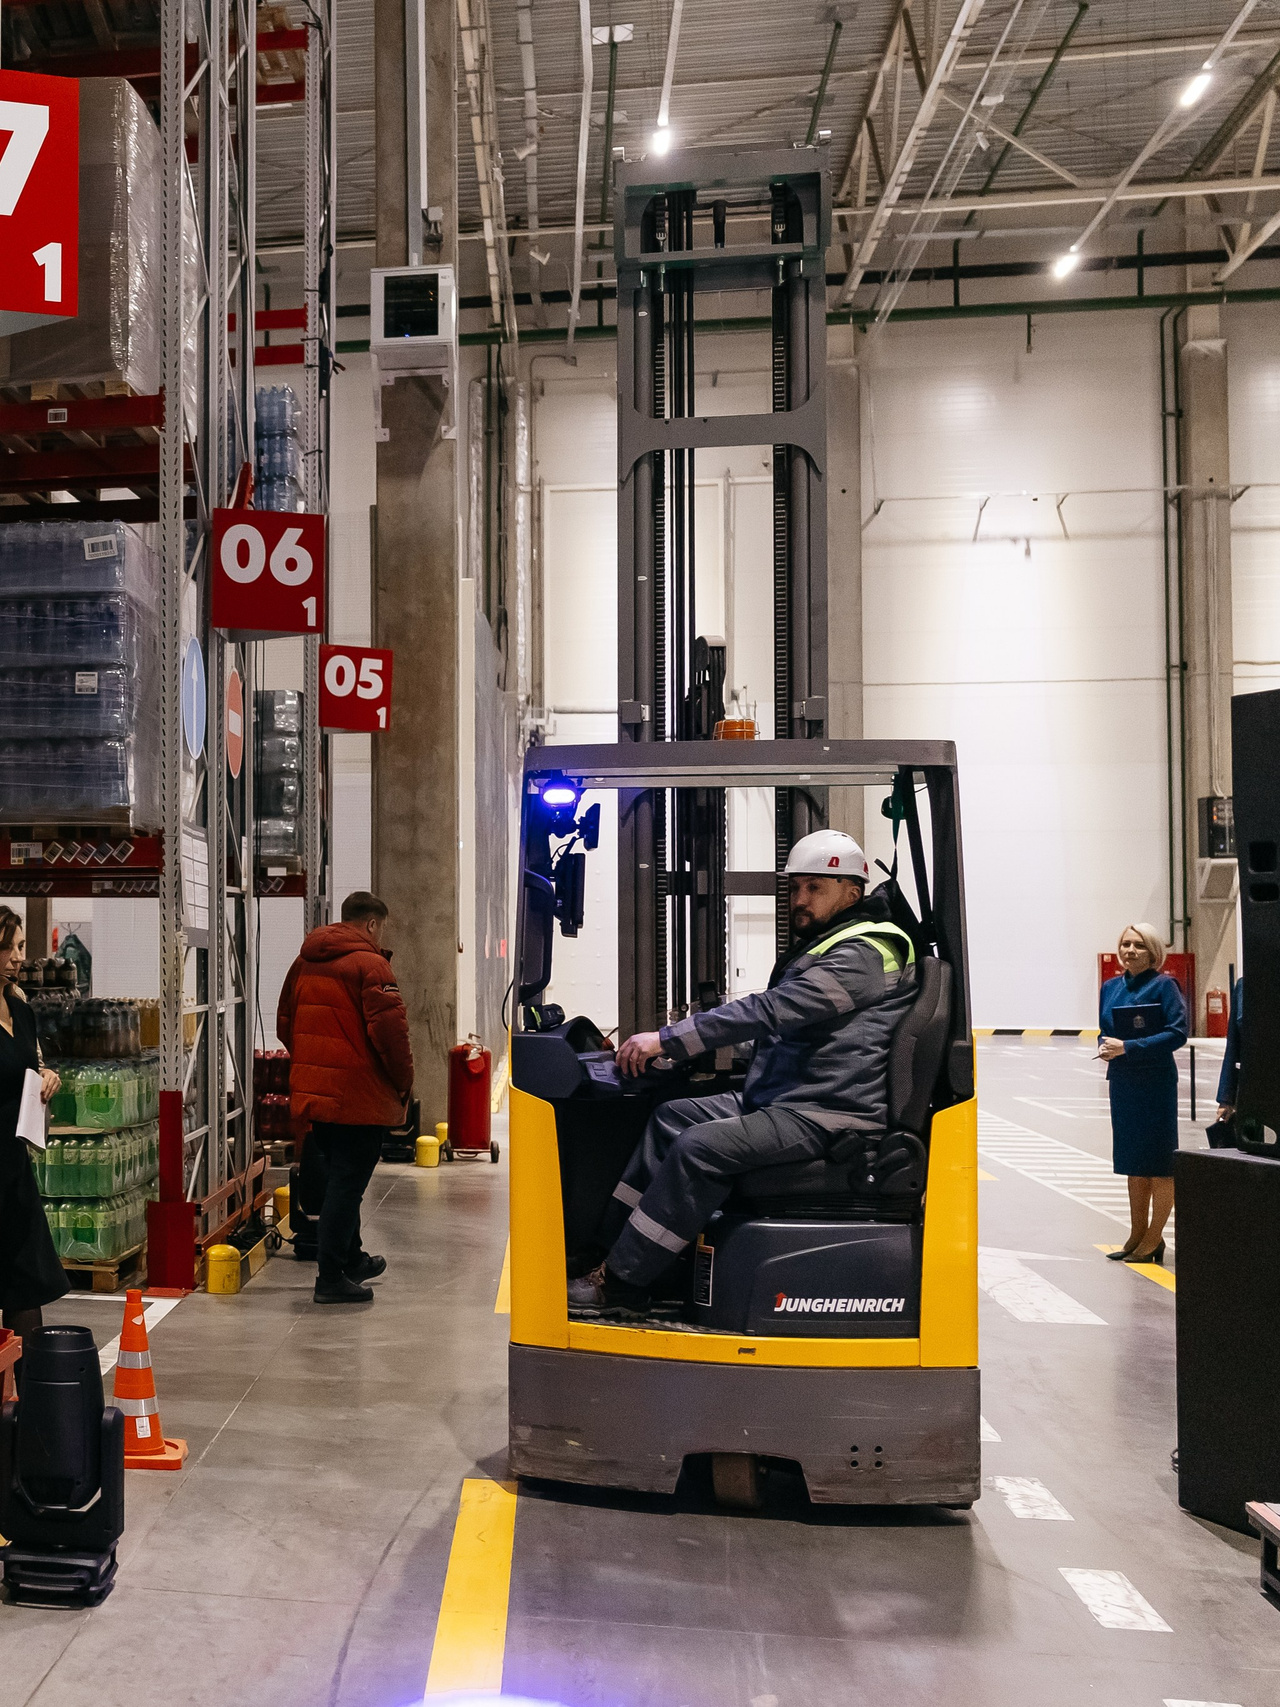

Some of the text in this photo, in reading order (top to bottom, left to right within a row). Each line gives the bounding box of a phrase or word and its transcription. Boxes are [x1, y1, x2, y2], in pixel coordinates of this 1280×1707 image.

[32, 242, 62, 302] 1
[220, 523, 314, 587] 06
[301, 596, 317, 627] 1
[324, 654, 384, 700] 05
[376, 706, 387, 729] 1
[774, 1297, 905, 1313] JUNGHEINRICH
